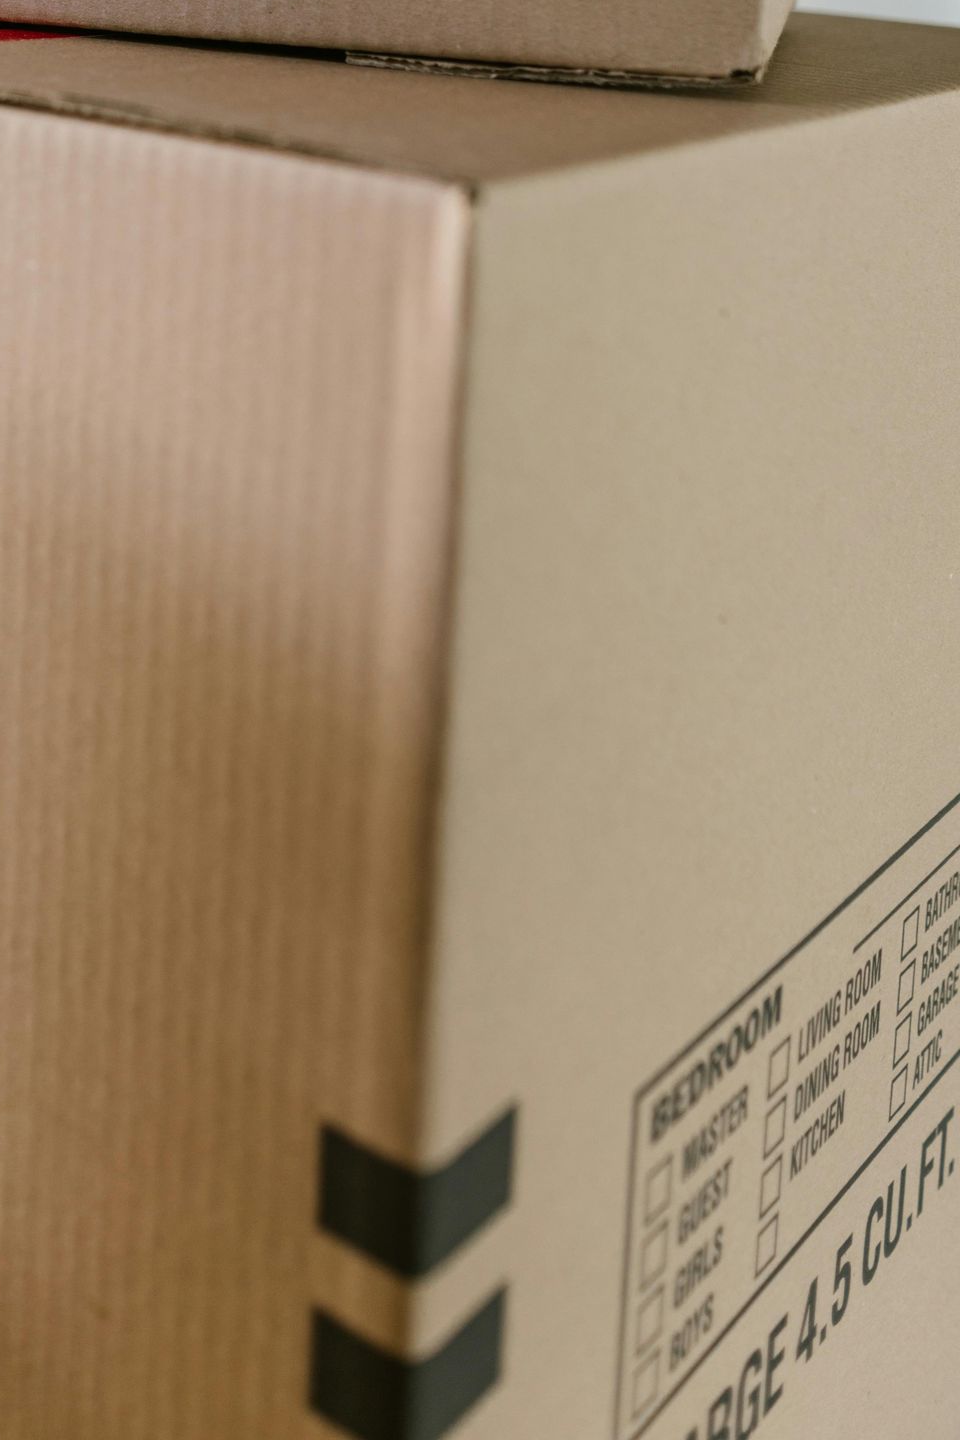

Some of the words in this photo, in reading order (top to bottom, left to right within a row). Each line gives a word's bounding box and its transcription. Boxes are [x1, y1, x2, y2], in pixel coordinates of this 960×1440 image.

[925, 871, 960, 932] BATHR
[798, 989, 841, 1064] LIVING
[844, 948, 882, 1015] ROOM
[917, 962, 960, 1037] GARAGE
[651, 984, 783, 1142] BEDROOM
[794, 1043, 841, 1124] DINING
[843, 1000, 881, 1071] ROOM
[912, 1028, 943, 1090] ATTIC
[682, 1085, 748, 1180] MASTER
[789, 1089, 846, 1182] KITCHEN
[677, 1157, 732, 1246] GUEST
[796, 1232, 854, 1363] 4.5
[862, 1164, 913, 1286] CU.
[917, 1105, 955, 1218] FT.
[673, 1226, 723, 1309] GIRLS
[669, 1293, 714, 1372] BOYS
